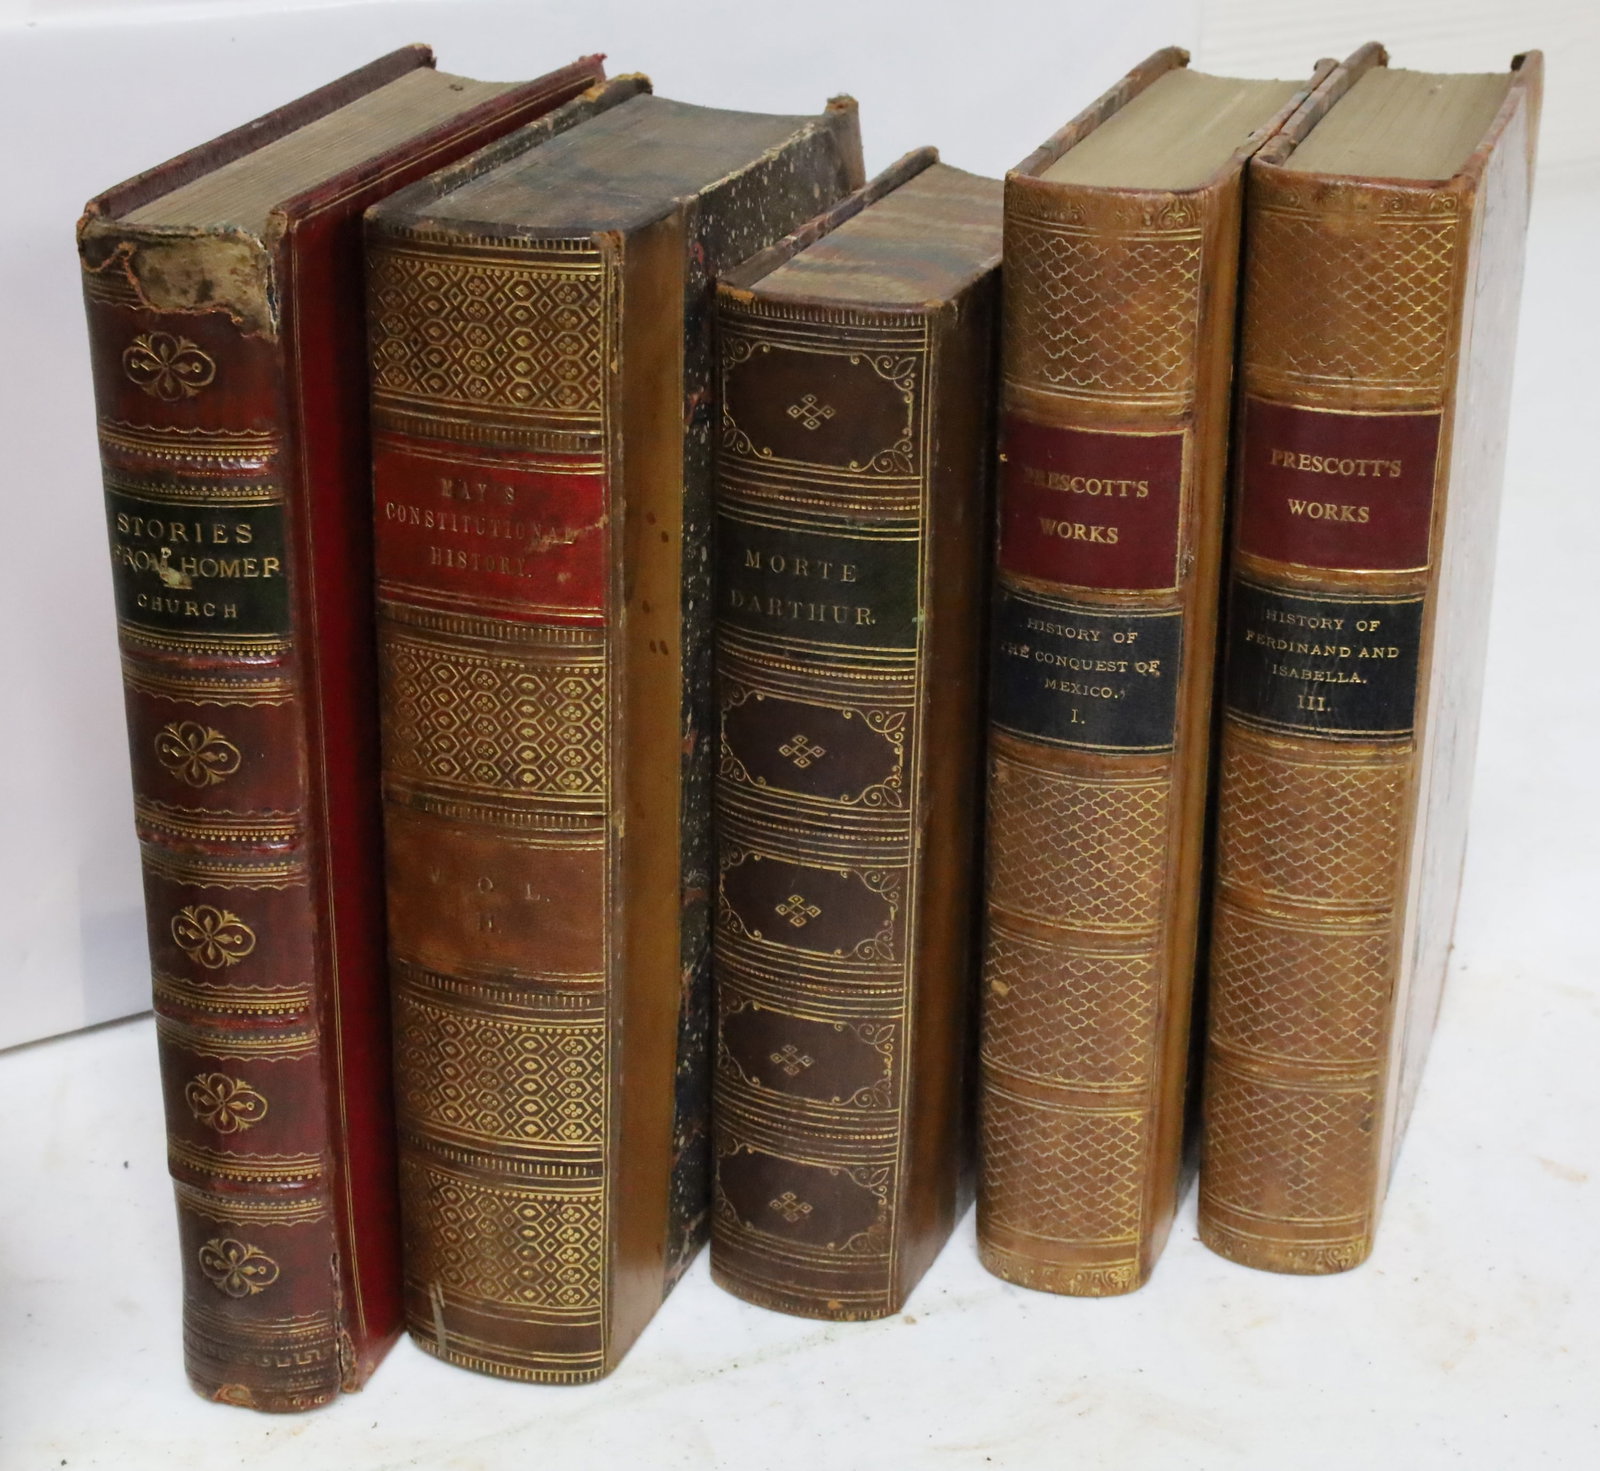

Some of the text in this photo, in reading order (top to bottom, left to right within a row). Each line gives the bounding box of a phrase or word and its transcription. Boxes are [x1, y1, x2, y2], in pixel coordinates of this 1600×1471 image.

[1270, 449, 1402, 478] PRESCOTT'S
[1024, 466, 1149, 498] PRESCOTT'S
[1287, 498, 1371, 524] WORKS
[116, 513, 253, 544] STORIES
[1038, 516, 1120, 544] WORKS
[180, 556, 280, 578] HOMER
[430, 546, 533, 578] HISTORY.
[744, 550, 857, 583] MORTE
[137, 593, 238, 619] CHURCH
[1026, 617, 1139, 645] HISTORY OF
[1265, 608, 1381, 633] HISTORY OF
[1245, 629, 1400, 659] FERDINAND AND
[1035, 650, 1129, 673] CONQUEST
[1133, 659, 1161, 675] OF
[1271, 663, 1368, 685] ISABELLA.
[1070, 708, 1086, 725] I.
[1296, 694, 1332, 713] III.
